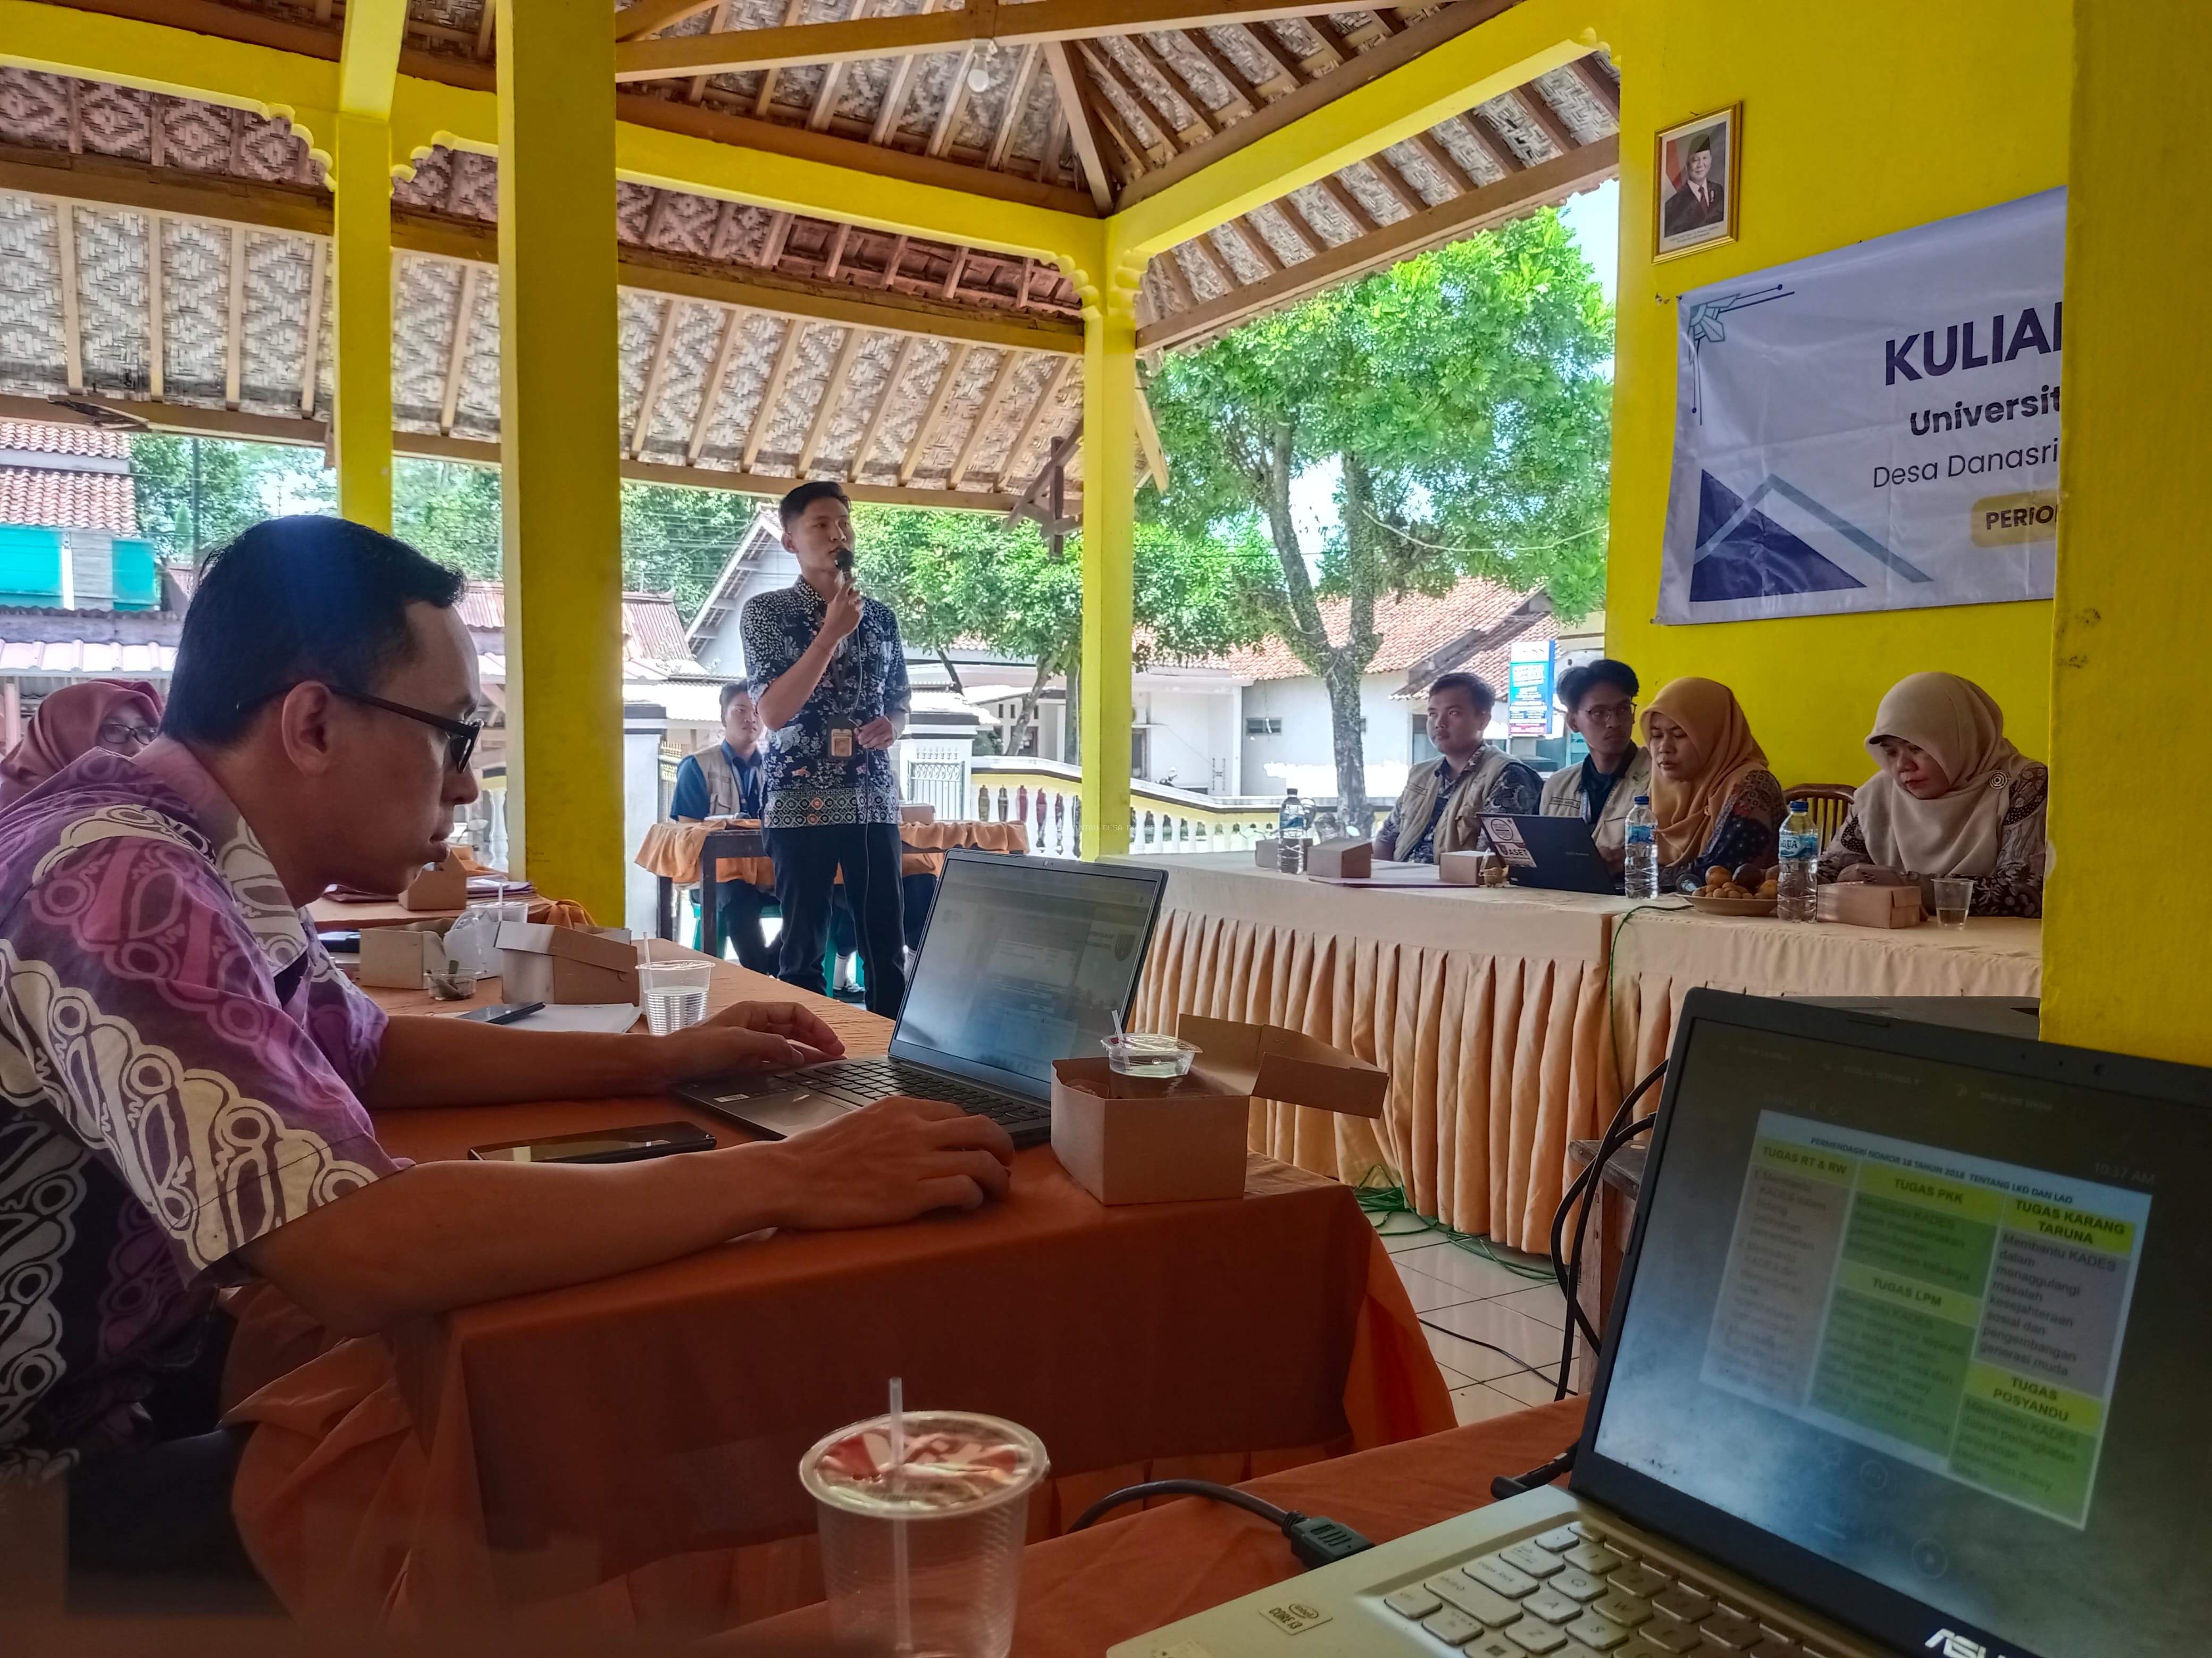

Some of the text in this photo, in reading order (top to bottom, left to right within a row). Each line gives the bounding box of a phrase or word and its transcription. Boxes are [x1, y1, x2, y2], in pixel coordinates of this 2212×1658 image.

[1873, 437, 2058, 488] Desa Danasri
[1985, 504, 2057, 530] PERIO
[1762, 1145, 1799, 1163] TUGAS
[1800, 1156, 1815, 1167] RT
[1828, 1163, 1848, 1175] RW
[1868, 1150, 1900, 1164] NOMOR
[1914, 1160, 1943, 1174] TAHUN
[1945, 1168, 1965, 1179] 2018
[1969, 1173, 2011, 1190] TENTANG
[2031, 1188, 2052, 1200] DAN
[2054, 1192, 2073, 1205] LAD
[1893, 1178, 1965, 1204] TUGAS PKK
[2014, 1199, 2126, 1235] TUGAS KARANG
[2037, 1221, 2094, 1244] TARUNA
[1999, 1249, 2036, 1268] dalam
[2002, 1233, 2116, 1272] Membantu KADES
[1872, 1277, 1943, 1306] TUGAS LPM
[1992, 1281, 2043, 1302] masalah
[1986, 1311, 2046, 1335] sosial dan
[1982, 1326, 2077, 1362] pengembangan
[2033, 1358, 2068, 1377] muda
[2011, 1376, 2058, 1401] TUGAS
[1993, 1388, 2070, 1423] POSYANDU
[1571, 1578, 1587, 1588] Q
[1546, 1601, 1559, 1610] A
